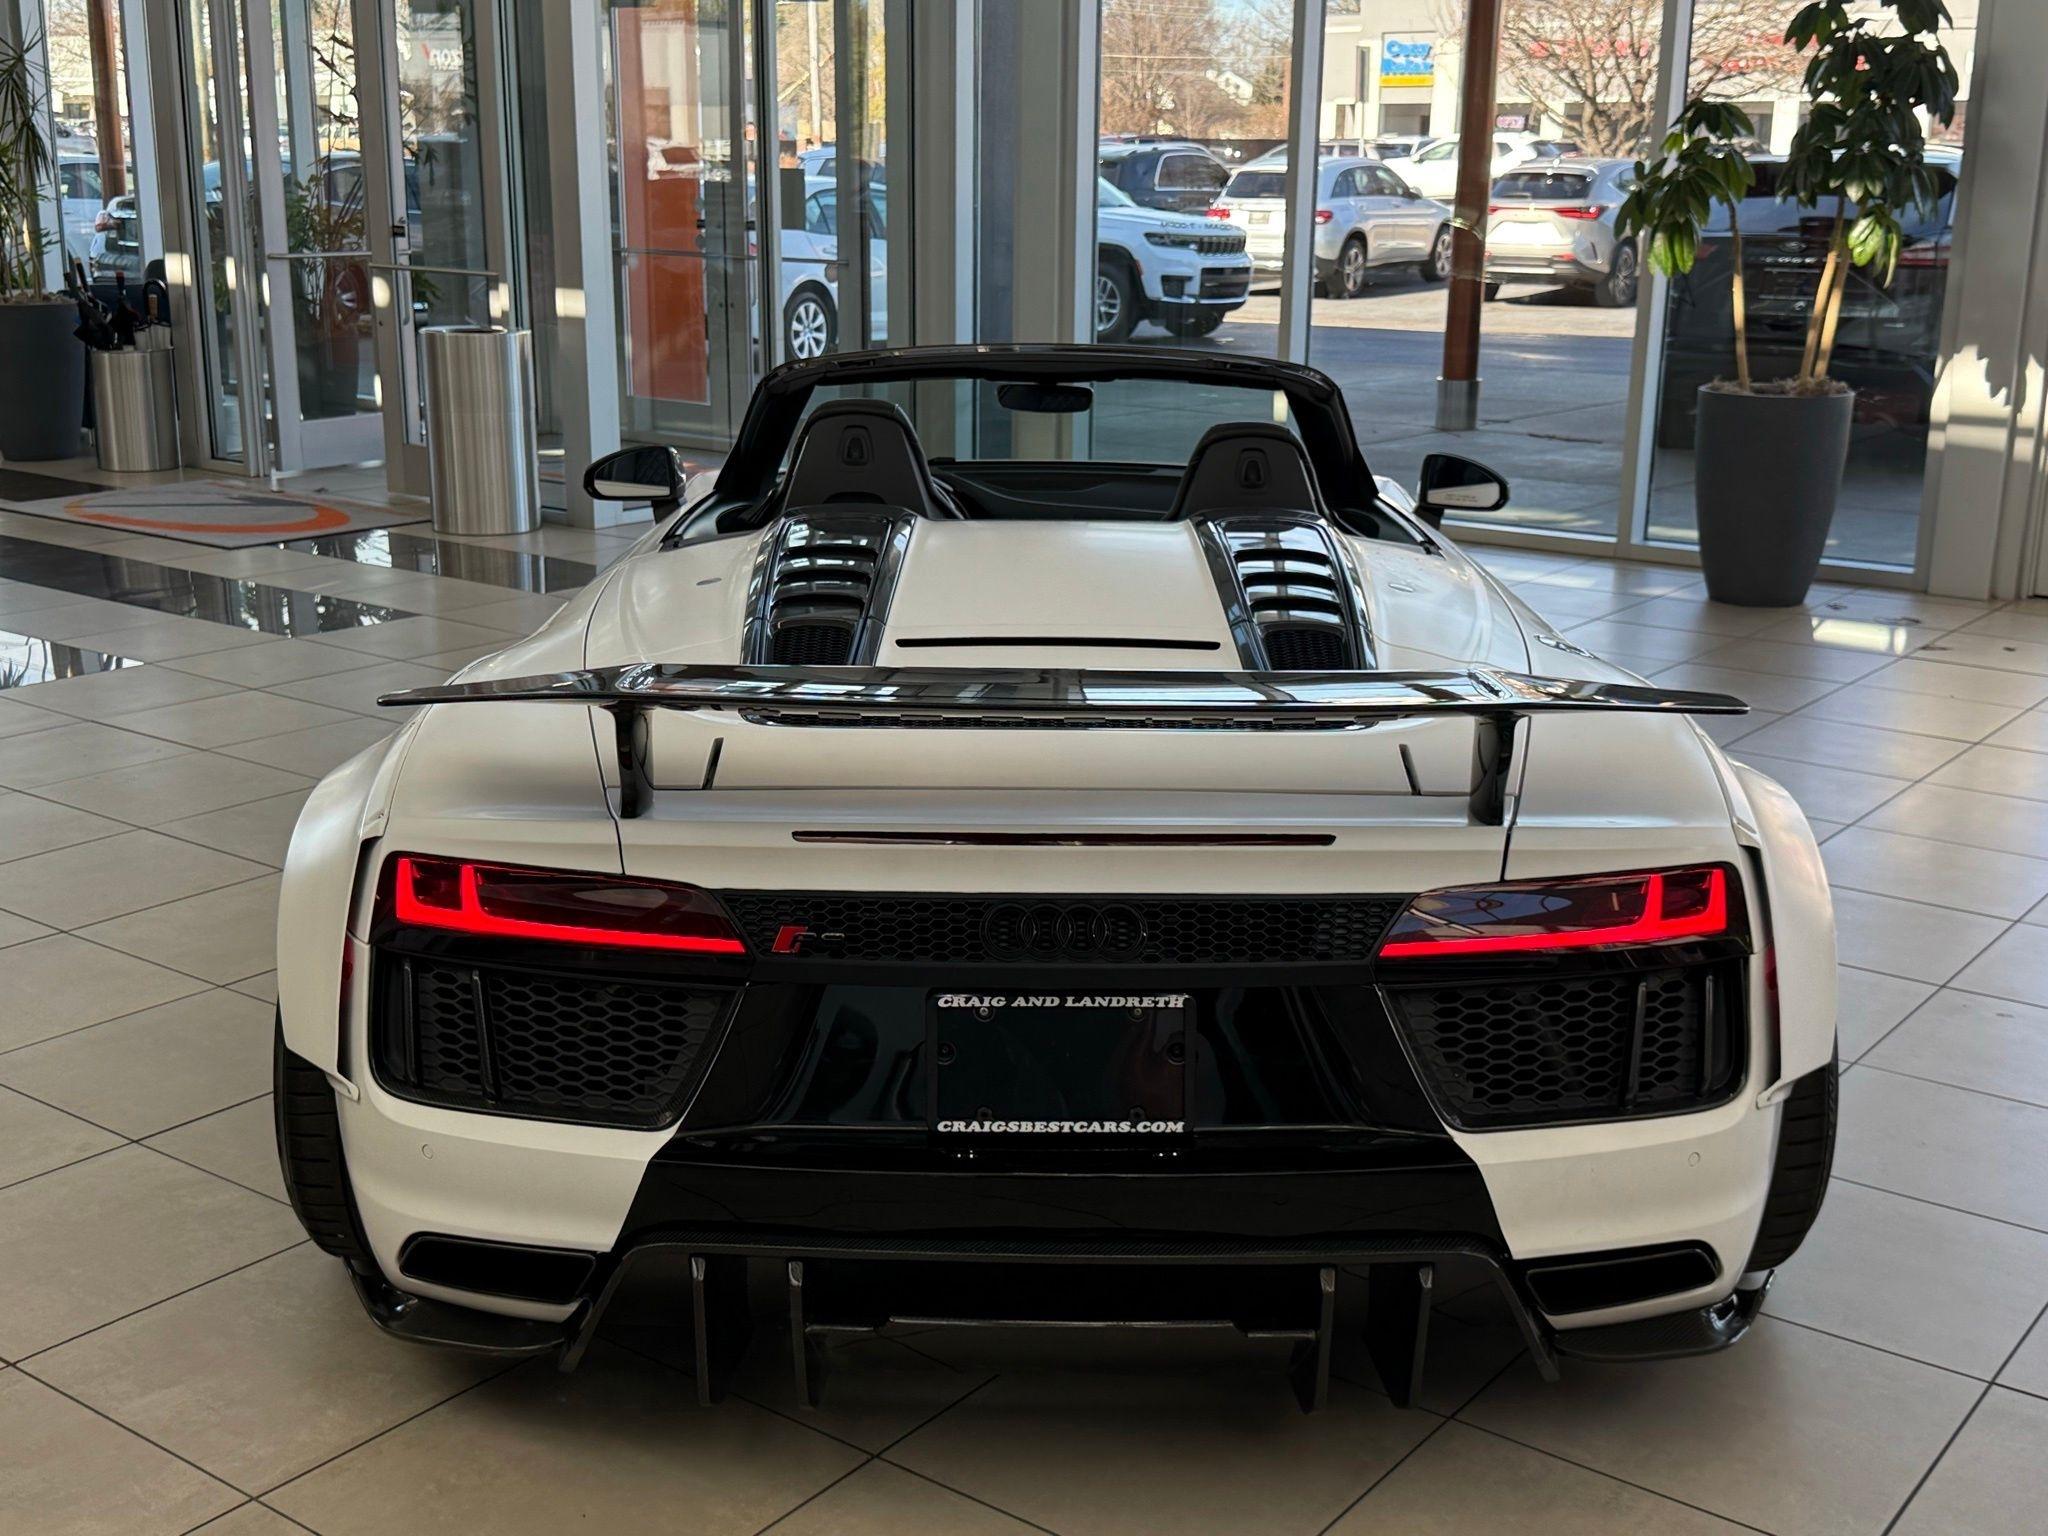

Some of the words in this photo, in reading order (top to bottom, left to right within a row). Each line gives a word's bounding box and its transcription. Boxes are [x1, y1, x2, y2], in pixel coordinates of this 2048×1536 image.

[937, 995, 1007, 1008] CRAIG
[1010, 996, 1061, 1007] AND
[1064, 995, 1184, 1008] LANDRETH
[936, 1120, 1185, 1133] CRAIGSBESTCARS.COM
